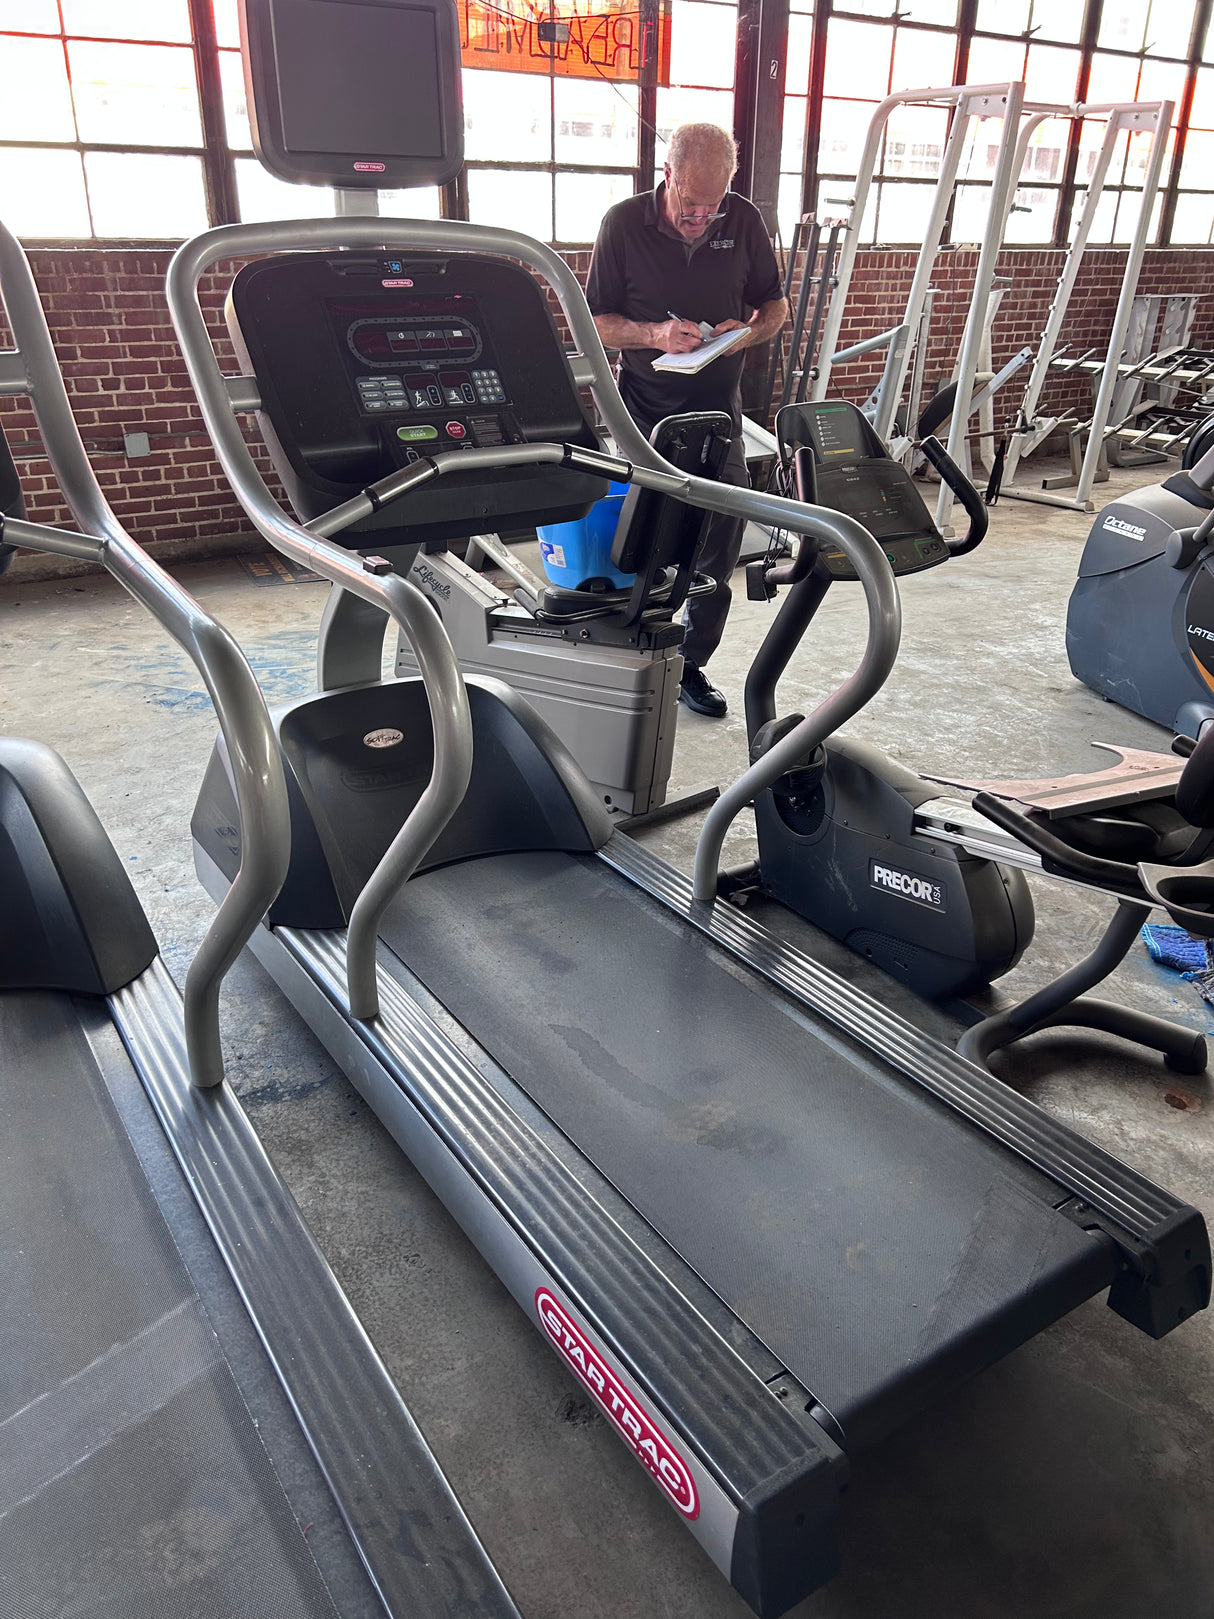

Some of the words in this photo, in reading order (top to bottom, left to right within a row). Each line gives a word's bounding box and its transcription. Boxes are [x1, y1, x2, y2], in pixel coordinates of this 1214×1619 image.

[771, 61, 777, 78] 2
[1104, 515, 1147, 536] Octane
[412, 565, 451, 598] Lifecycle
[874, 864, 933, 902] PRECOR
[933, 886, 941, 905] USA
[545, 1309, 605, 1393] STAR
[608, 1386, 681, 1490] TRAC
